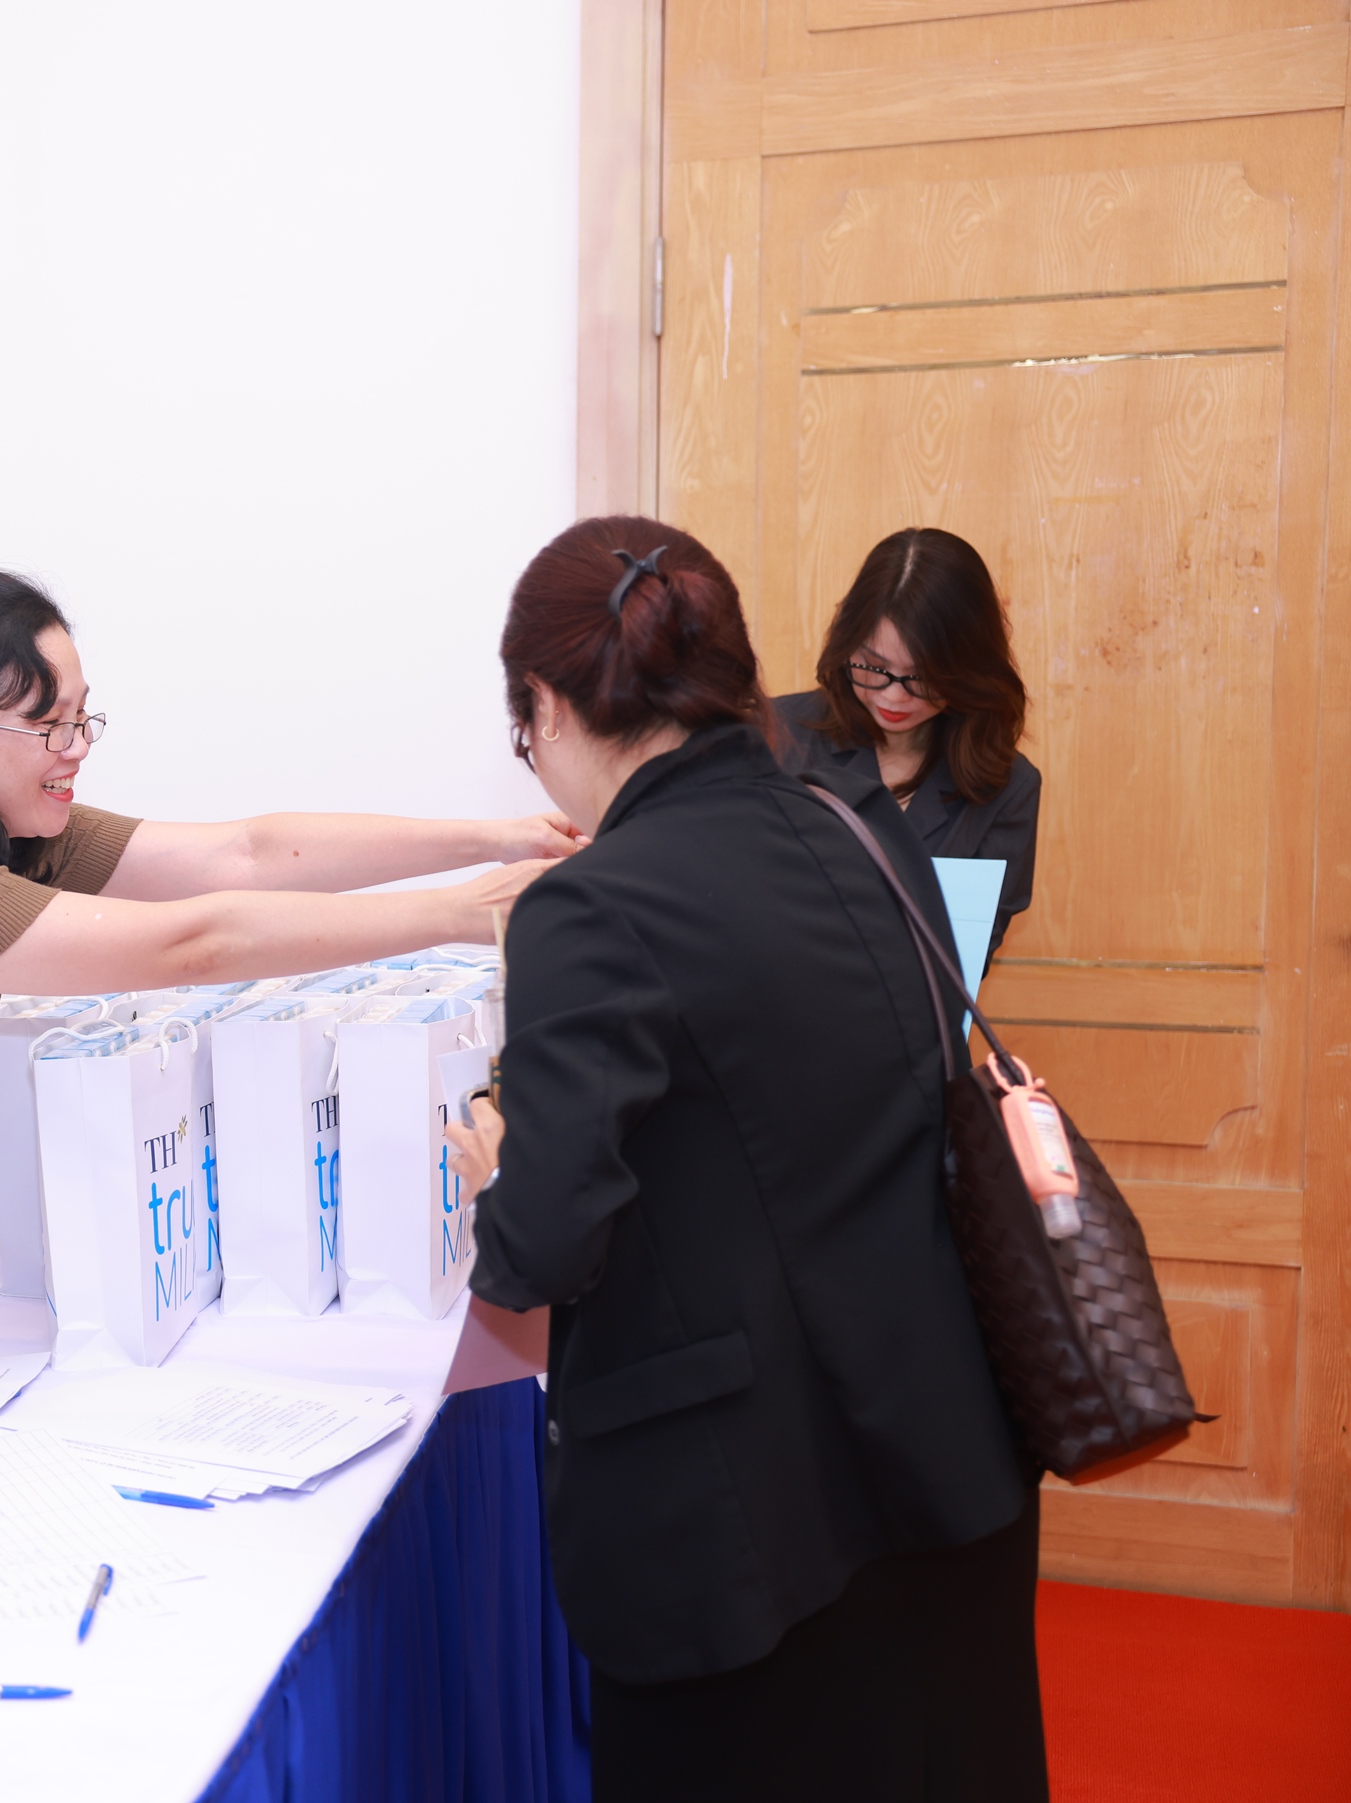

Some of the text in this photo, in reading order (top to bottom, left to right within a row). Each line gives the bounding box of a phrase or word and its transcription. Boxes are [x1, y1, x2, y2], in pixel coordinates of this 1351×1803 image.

[144, 1131, 177, 1174] TH
[200, 1101, 215, 1138] T
[314, 1141, 339, 1210] tr
[148, 1179, 194, 1255] tru
[443, 1208, 472, 1276] MIL
[155, 1234, 195, 1322] MIL
